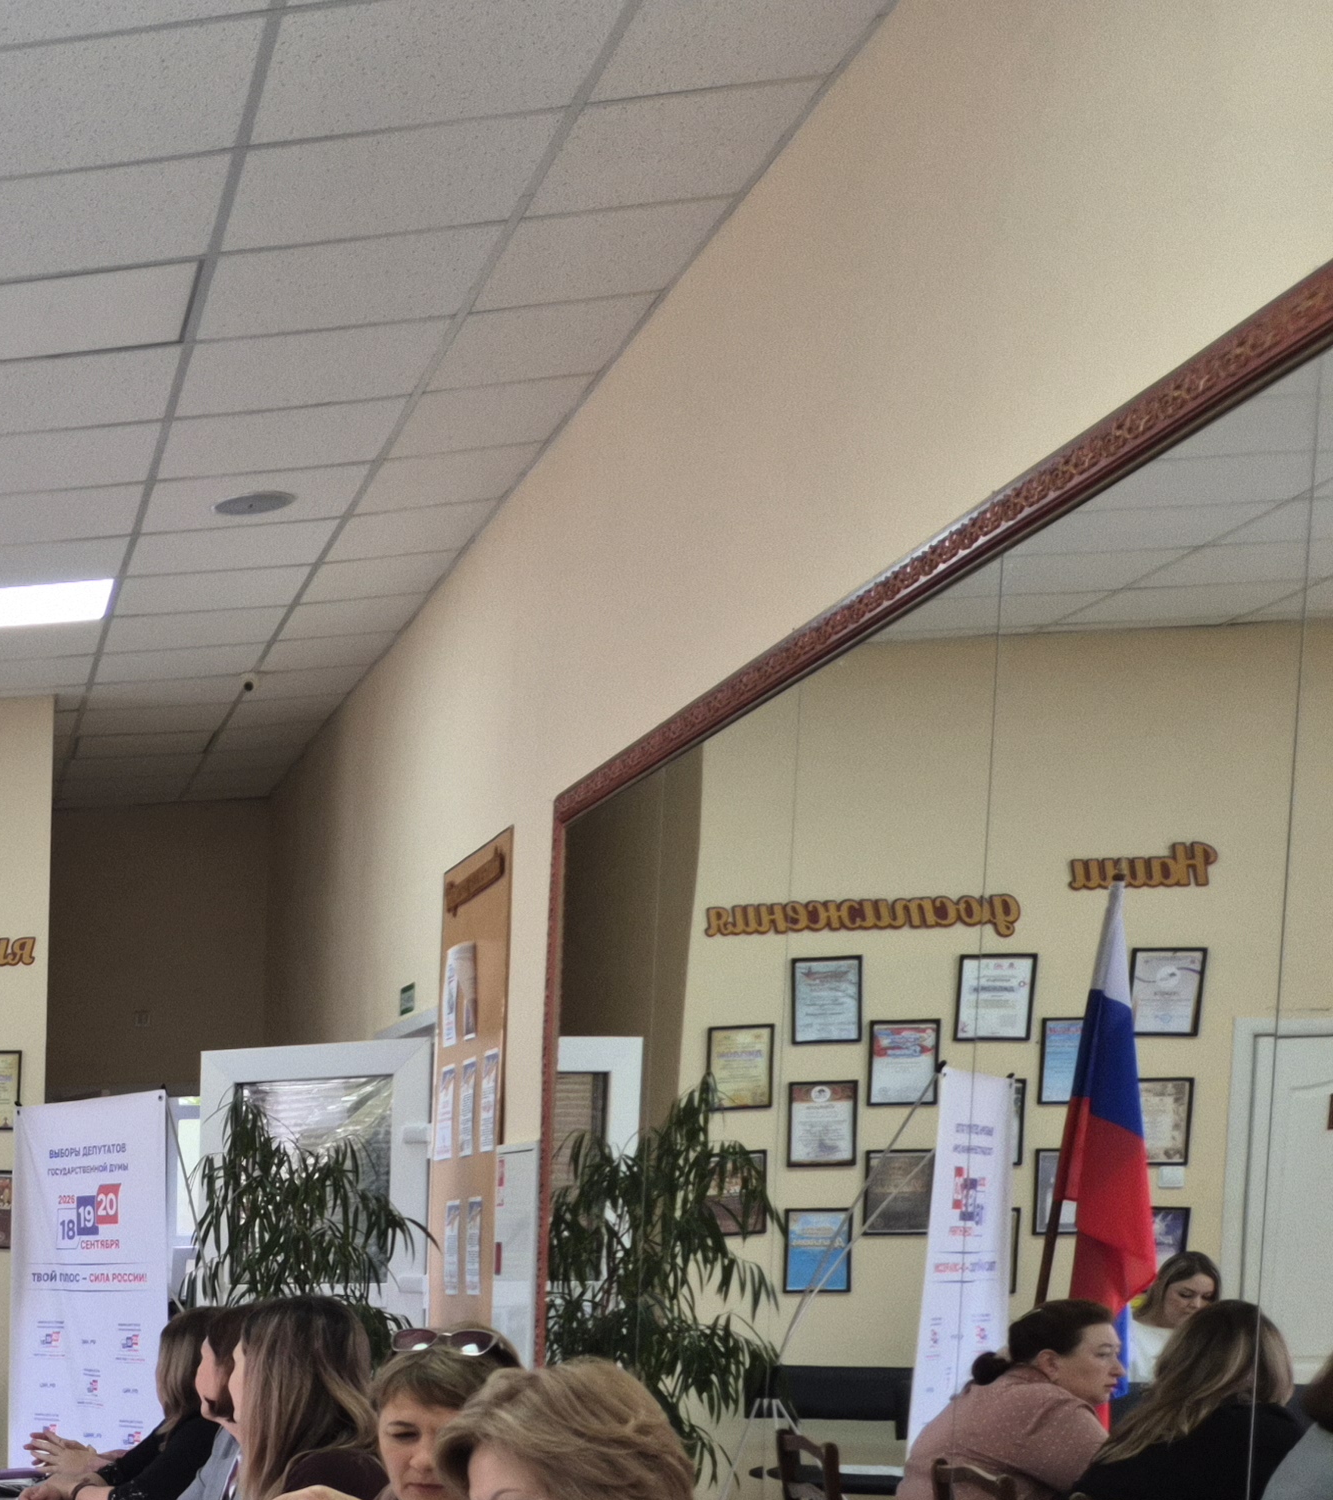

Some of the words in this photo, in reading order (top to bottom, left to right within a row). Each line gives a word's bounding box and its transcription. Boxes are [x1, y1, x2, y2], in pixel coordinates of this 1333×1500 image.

[49, 1147, 81, 1159] ВЫБОРЫ
[82, 1142, 127, 1157] ДЕПУТАТОВ
[47, 1162, 108, 1176] ГОСУДАРСТВЕННОЙ
[108, 1162, 129, 1173] ДУМЫ
[58, 1195, 75, 1205] 2026
[97, 1192, 117, 1216] 20
[78, 1205, 95, 1228] 19
[59, 1219, 76, 1241] 18
[80, 1239, 120, 1250] СЕНТЯБРЯ
[31, 1270, 58, 1283] ТВОЙ
[89, 1272, 110, 1283] СИЛА
[111, 1272, 148, 1283] РОССИИ!
